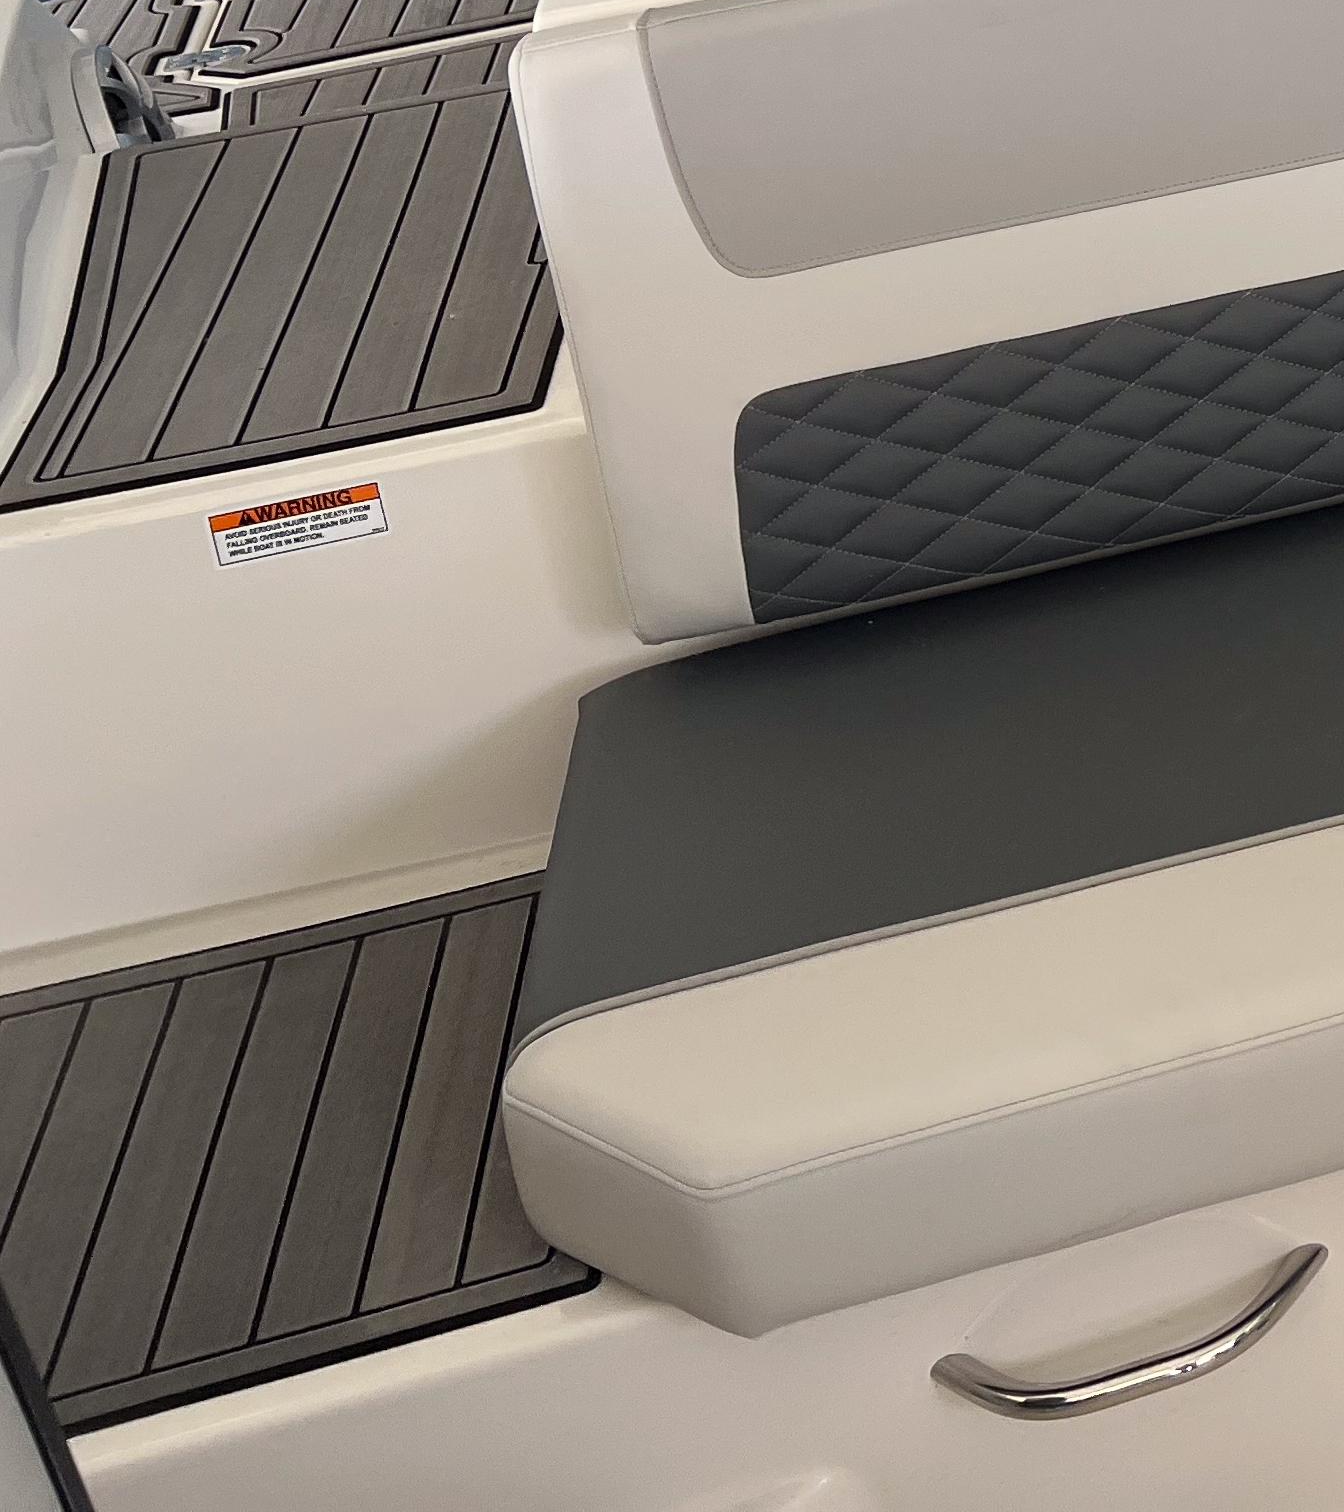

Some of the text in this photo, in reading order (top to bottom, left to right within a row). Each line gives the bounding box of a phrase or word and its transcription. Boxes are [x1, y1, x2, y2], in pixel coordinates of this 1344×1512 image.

[255, 490, 352, 522] WARNING
[310, 514, 322, 522] OR
[323, 509, 347, 519] DEATH
[348, 504, 370, 514] FROM
[225, 536, 258, 548] FALLING
[228, 546, 252, 557] WHILE
